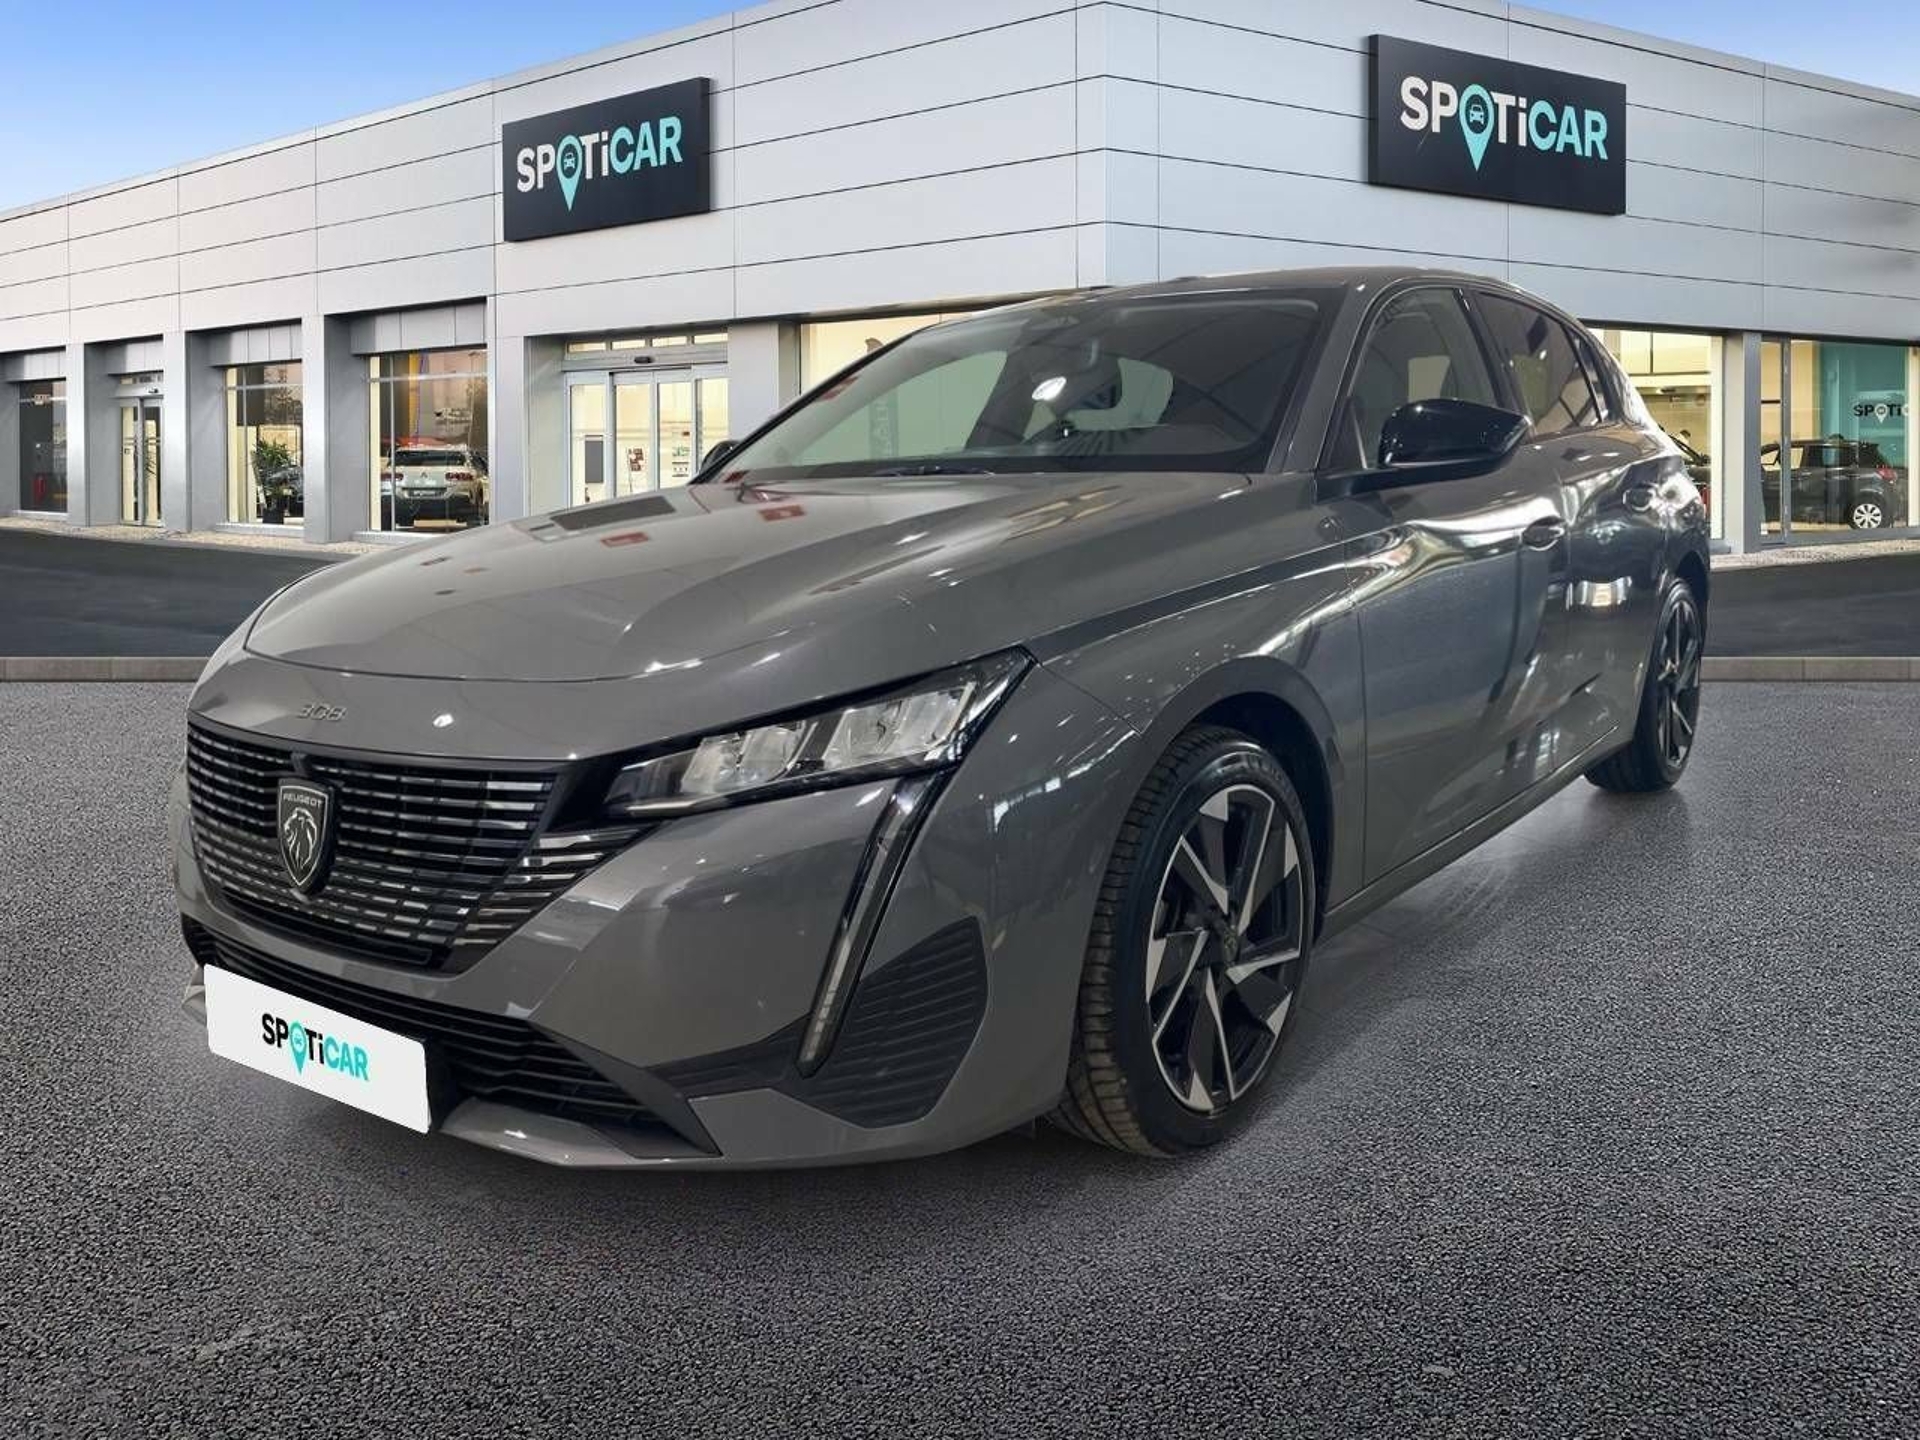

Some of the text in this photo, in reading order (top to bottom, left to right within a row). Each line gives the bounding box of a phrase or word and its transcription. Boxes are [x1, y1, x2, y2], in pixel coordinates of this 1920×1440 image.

[517, 116, 683, 211] SPOTiCAR
[1401, 76, 1608, 171] SPOTiCAR
[297, 704, 347, 721] 308
[262, 1014, 369, 1081] SPOTiCAR
